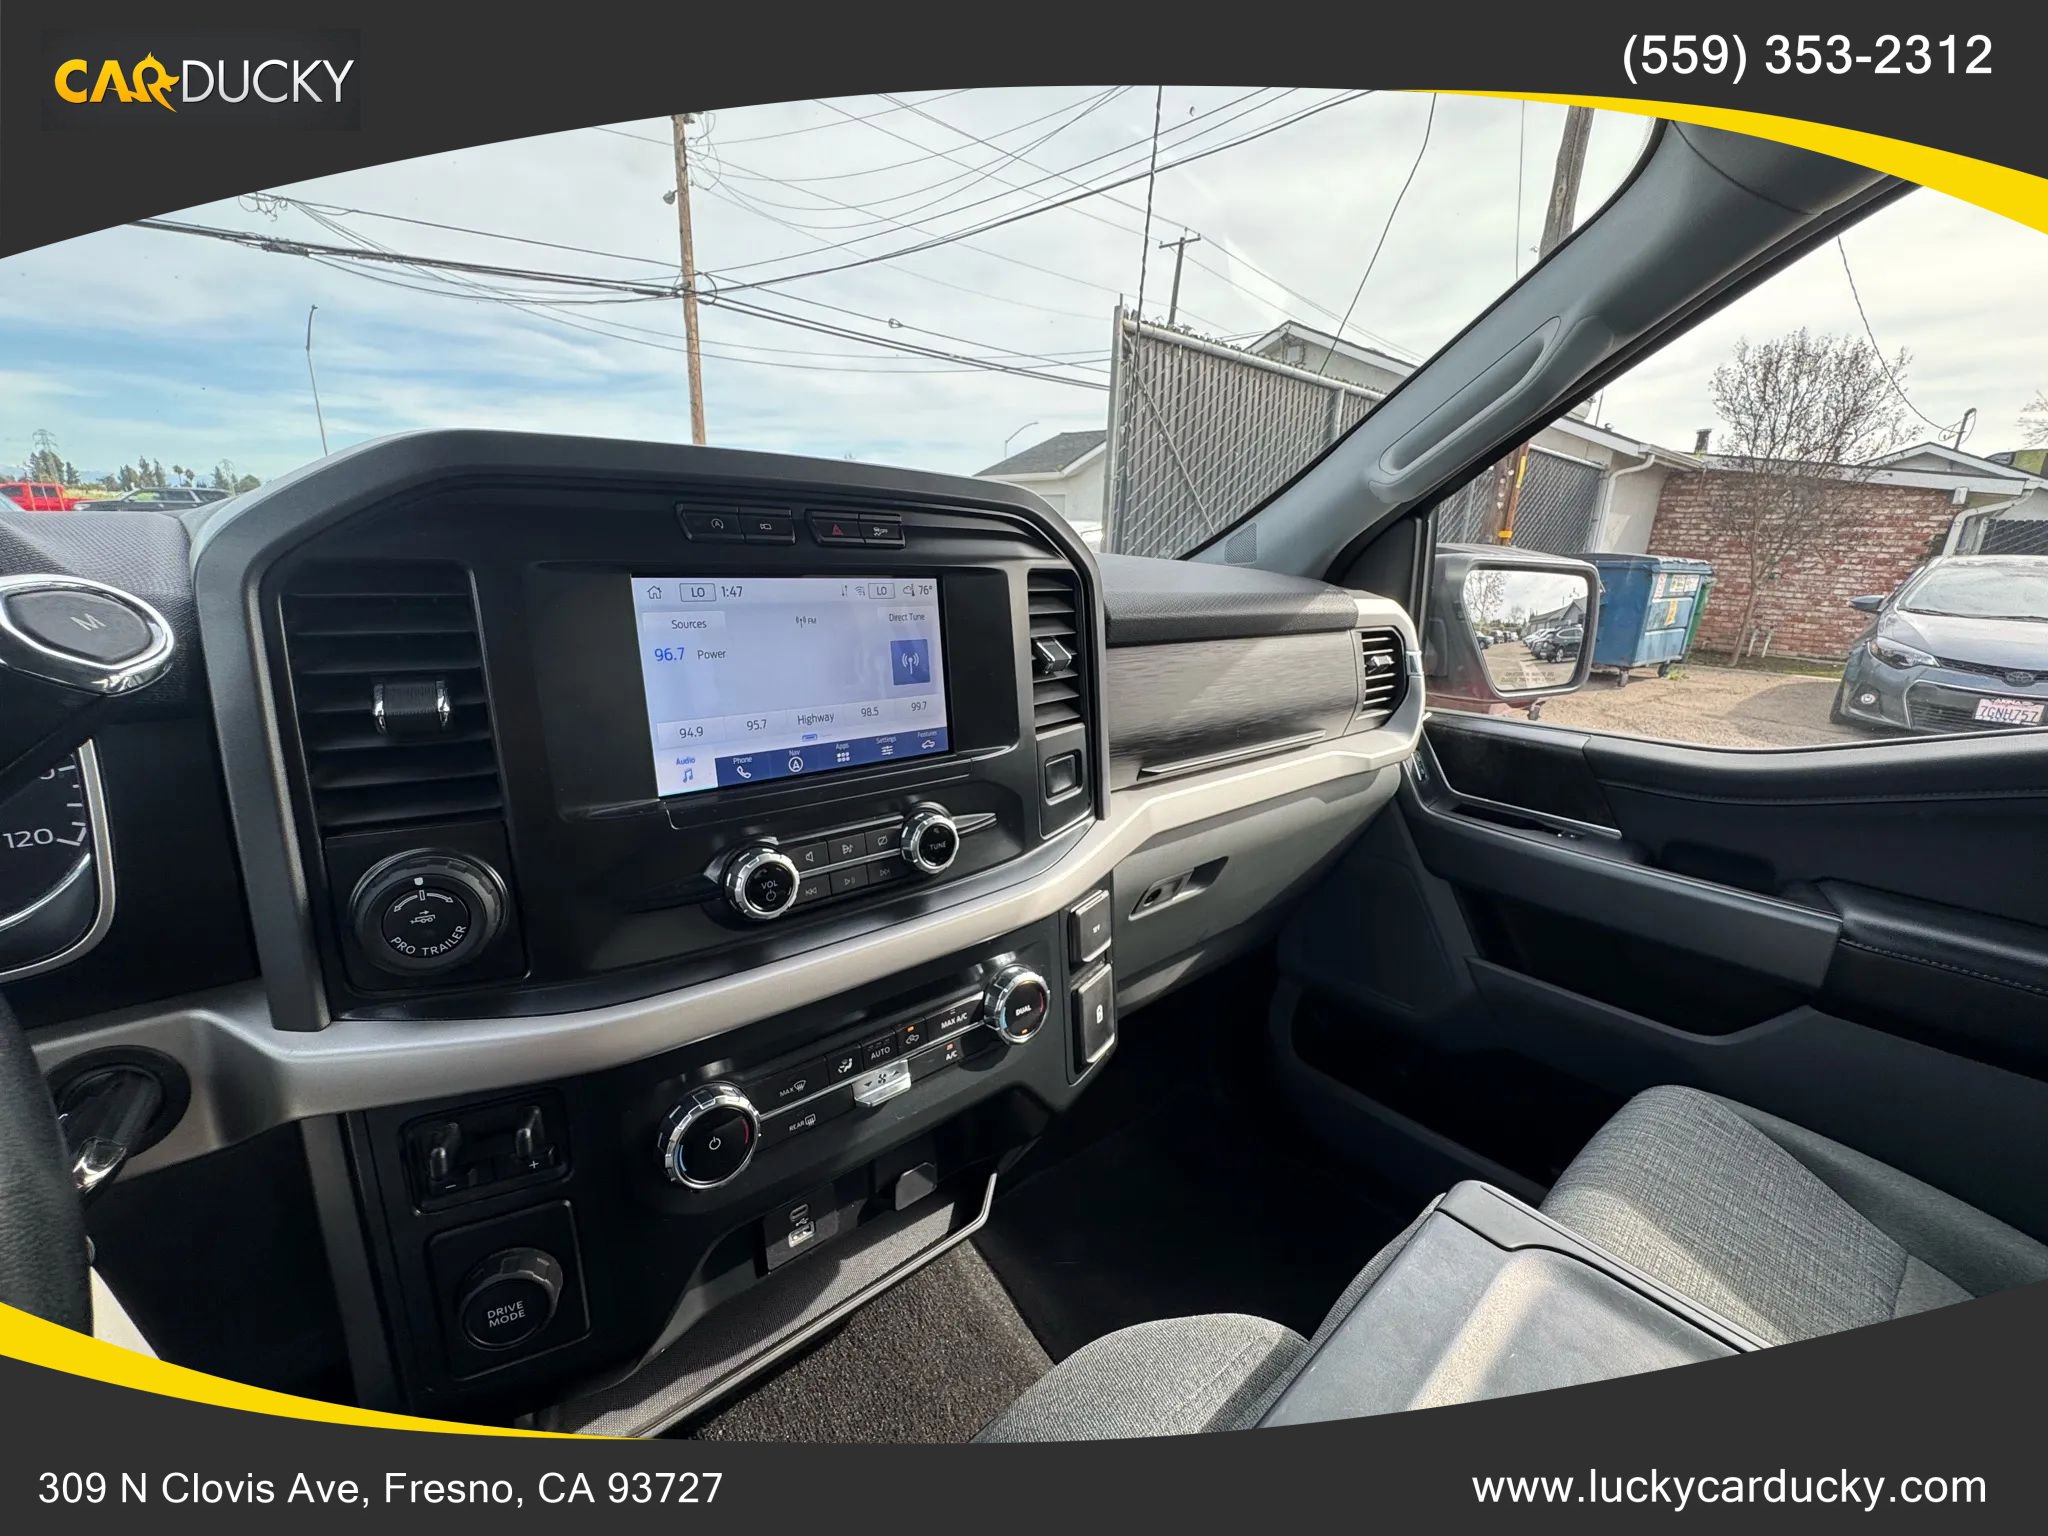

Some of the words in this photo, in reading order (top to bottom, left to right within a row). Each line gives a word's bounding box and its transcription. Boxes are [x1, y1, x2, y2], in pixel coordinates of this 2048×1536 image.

[691, 587, 706, 598] LO
[721, 586, 743, 598] 1:47
[876, 586, 887, 596] LO
[888, 612, 908, 622] Direct
[909, 612, 926, 621] Tune
[671, 619, 707, 630] Sources
[654, 647, 685, 662] 96.7
[697, 648, 727, 660] Power
[860, 706, 880, 718] 98.5
[911, 701, 927, 712] 99.7
[797, 712, 835, 726] Highway
[1980, 705, 2039, 723] 7GNH757
[746, 719, 767, 731] 95.7
[679, 726, 704, 739] 94.9
[875, 735, 897, 744] Settings
[789, 749, 801, 757] Nav
[835, 743, 850, 751] Apps
[675, 756, 696, 766] Audio
[732, 756, 752, 765] Phone
[2, 828, 54, 849] 120
[761, 880, 778, 890] VOL
[390, 936, 416, 956] PRO
[421, 925, 467, 957] TRAILER
[1015, 1004, 1032, 1017] DUAL
[940, 1018, 956, 1030] MAX
[956, 1012, 968, 1023] A/C
[870, 1046, 891, 1061] AUTO
[945, 1050, 958, 1061] A/C
[779, 1086, 795, 1098] MAX
[788, 1120, 805, 1132] REAR
[487, 1300, 524, 1319] DRIVE
[489, 1309, 526, 1328] MODE
